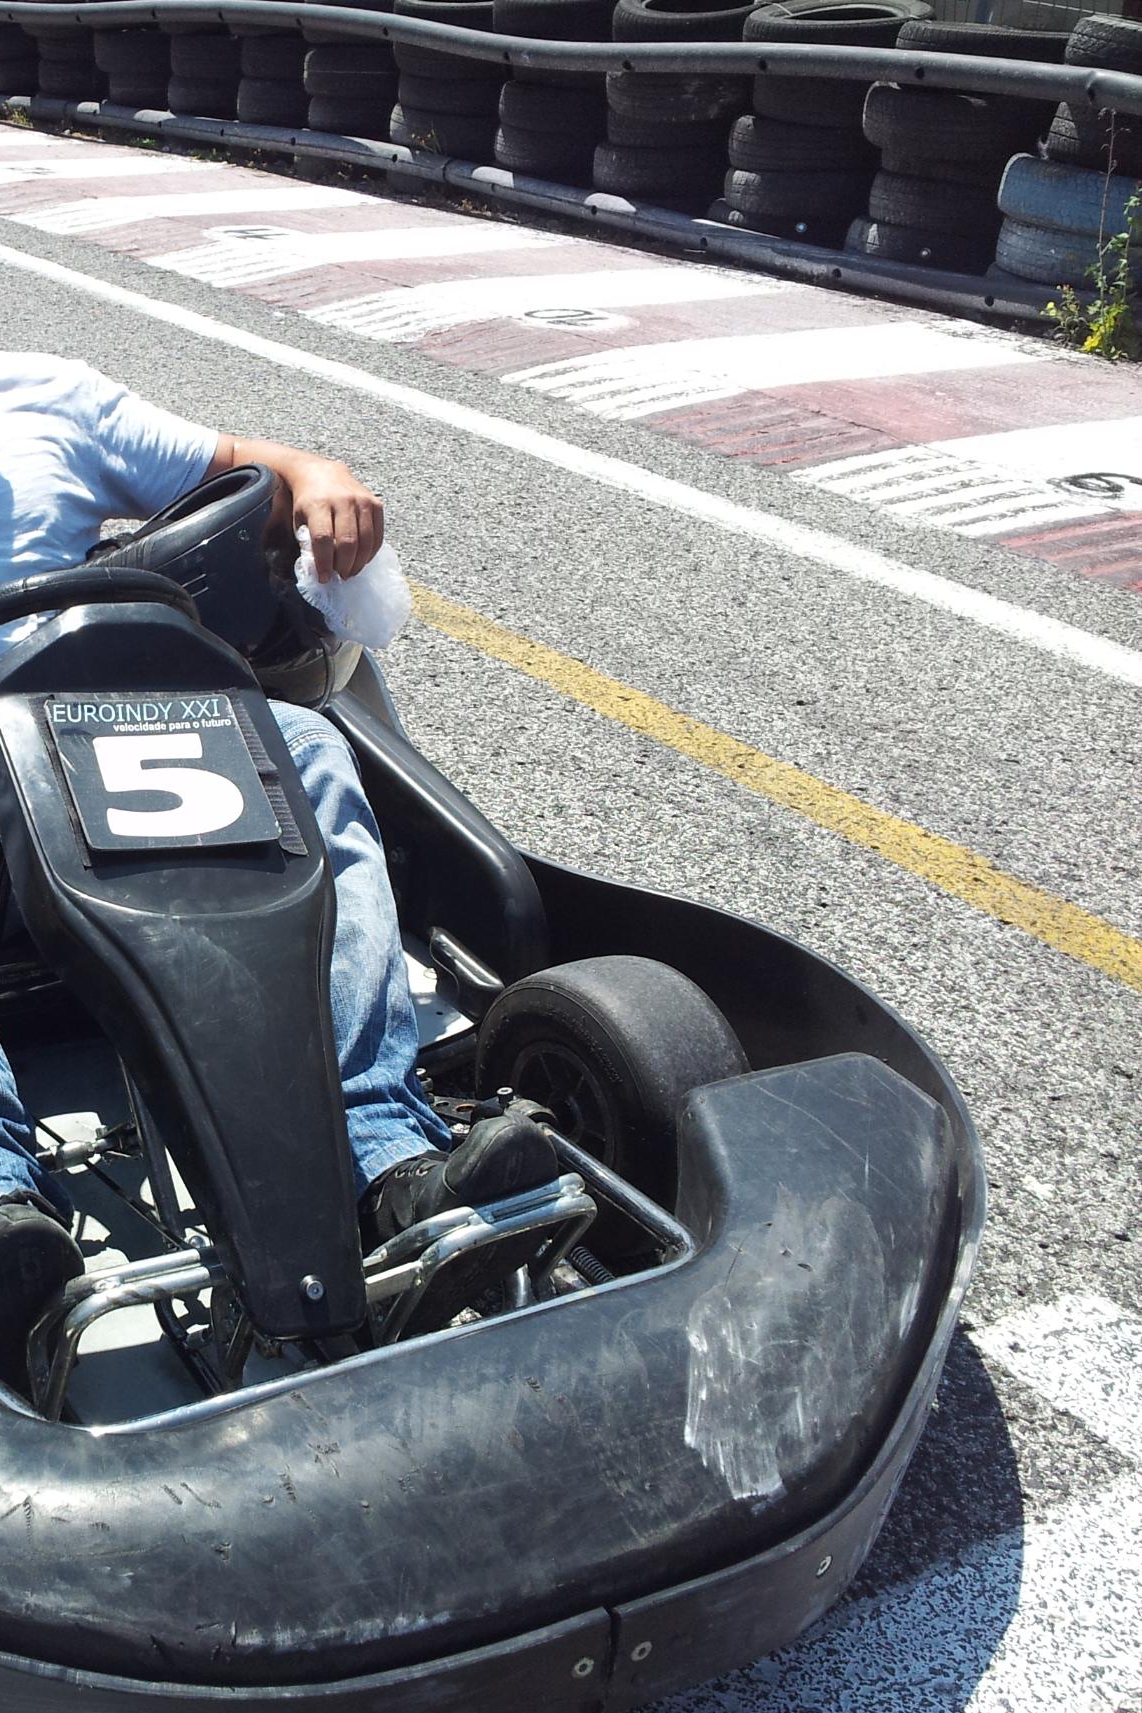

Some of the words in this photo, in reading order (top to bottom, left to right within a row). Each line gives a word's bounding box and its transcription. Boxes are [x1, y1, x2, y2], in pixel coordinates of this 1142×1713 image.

[52, 702, 172, 723] EUROINDY
[180, 698, 221, 719] XXI
[112, 721, 167, 733] velocidade
[168, 721, 191, 732] para
[192, 721, 200, 729] o
[201, 717, 232, 728] futuro
[92, 732, 245, 838] 5
